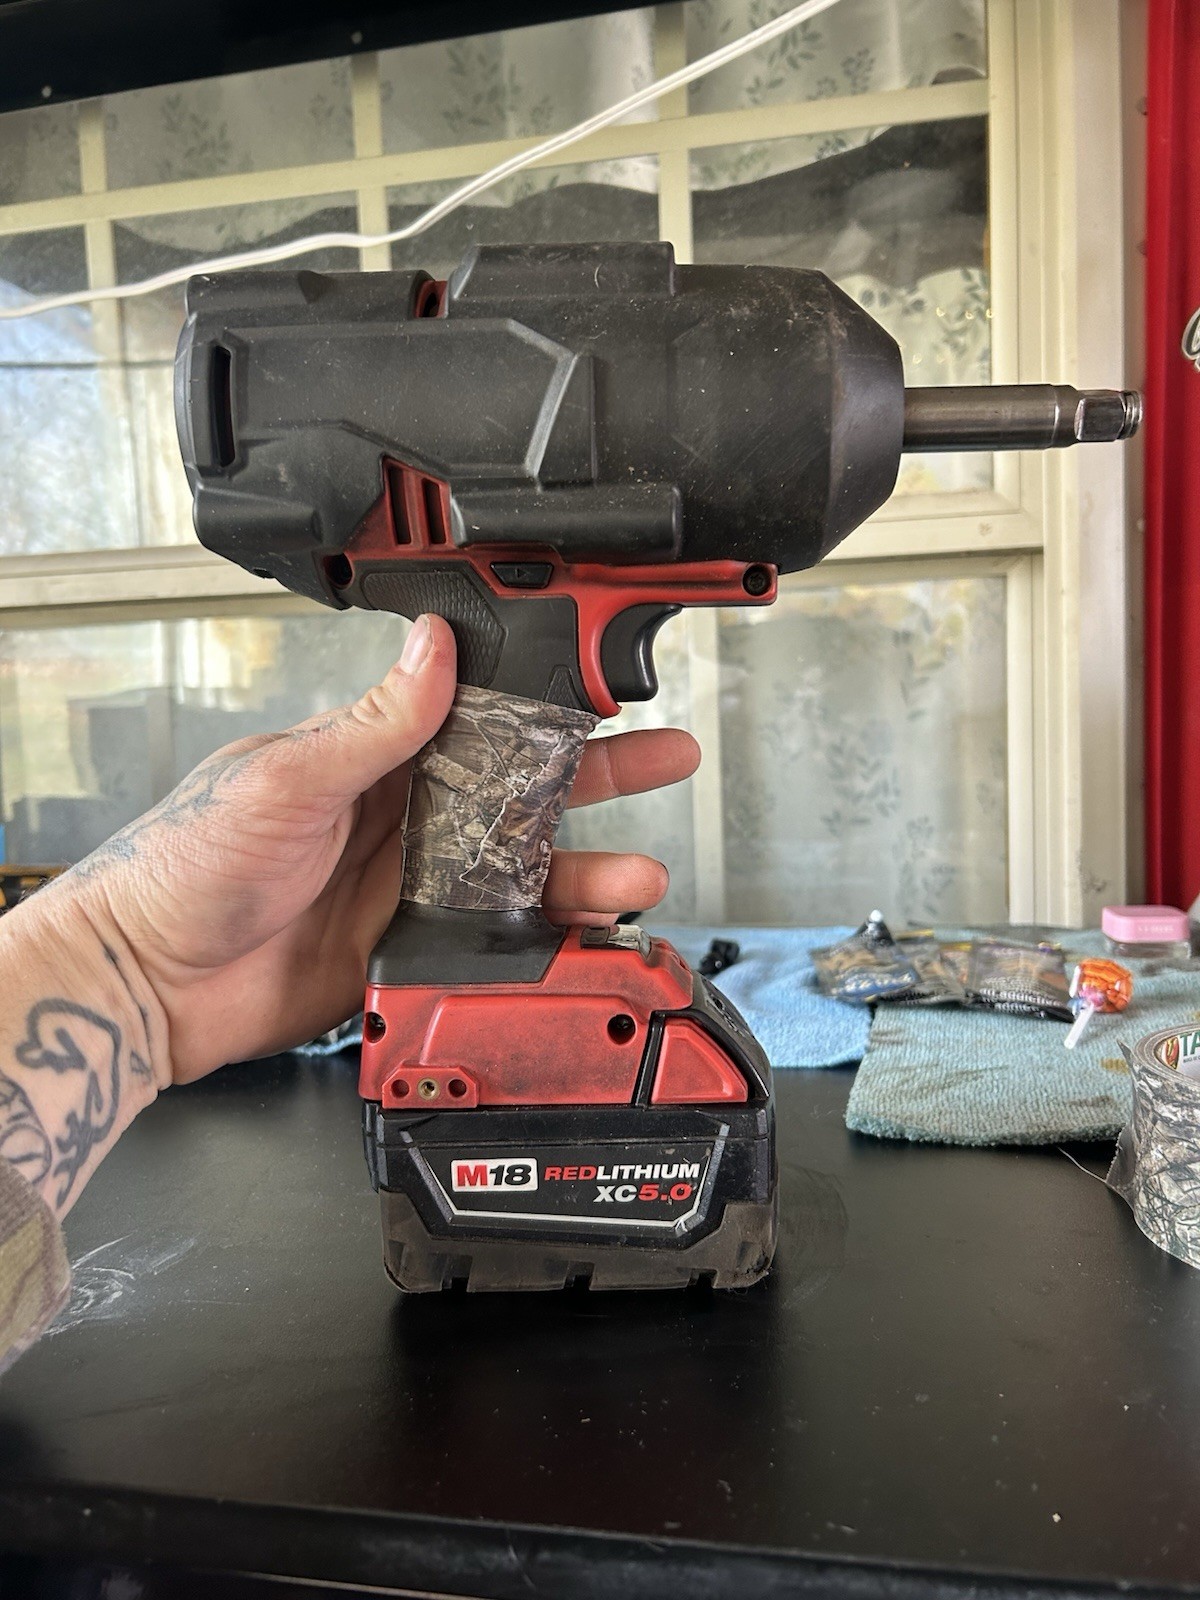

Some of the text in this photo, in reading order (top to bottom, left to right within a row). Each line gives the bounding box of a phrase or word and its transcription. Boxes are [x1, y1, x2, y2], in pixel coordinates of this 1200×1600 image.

[457, 1163, 700, 1187] M18 REDLITHIUM
[593, 1183, 693, 1203] XC5.0
